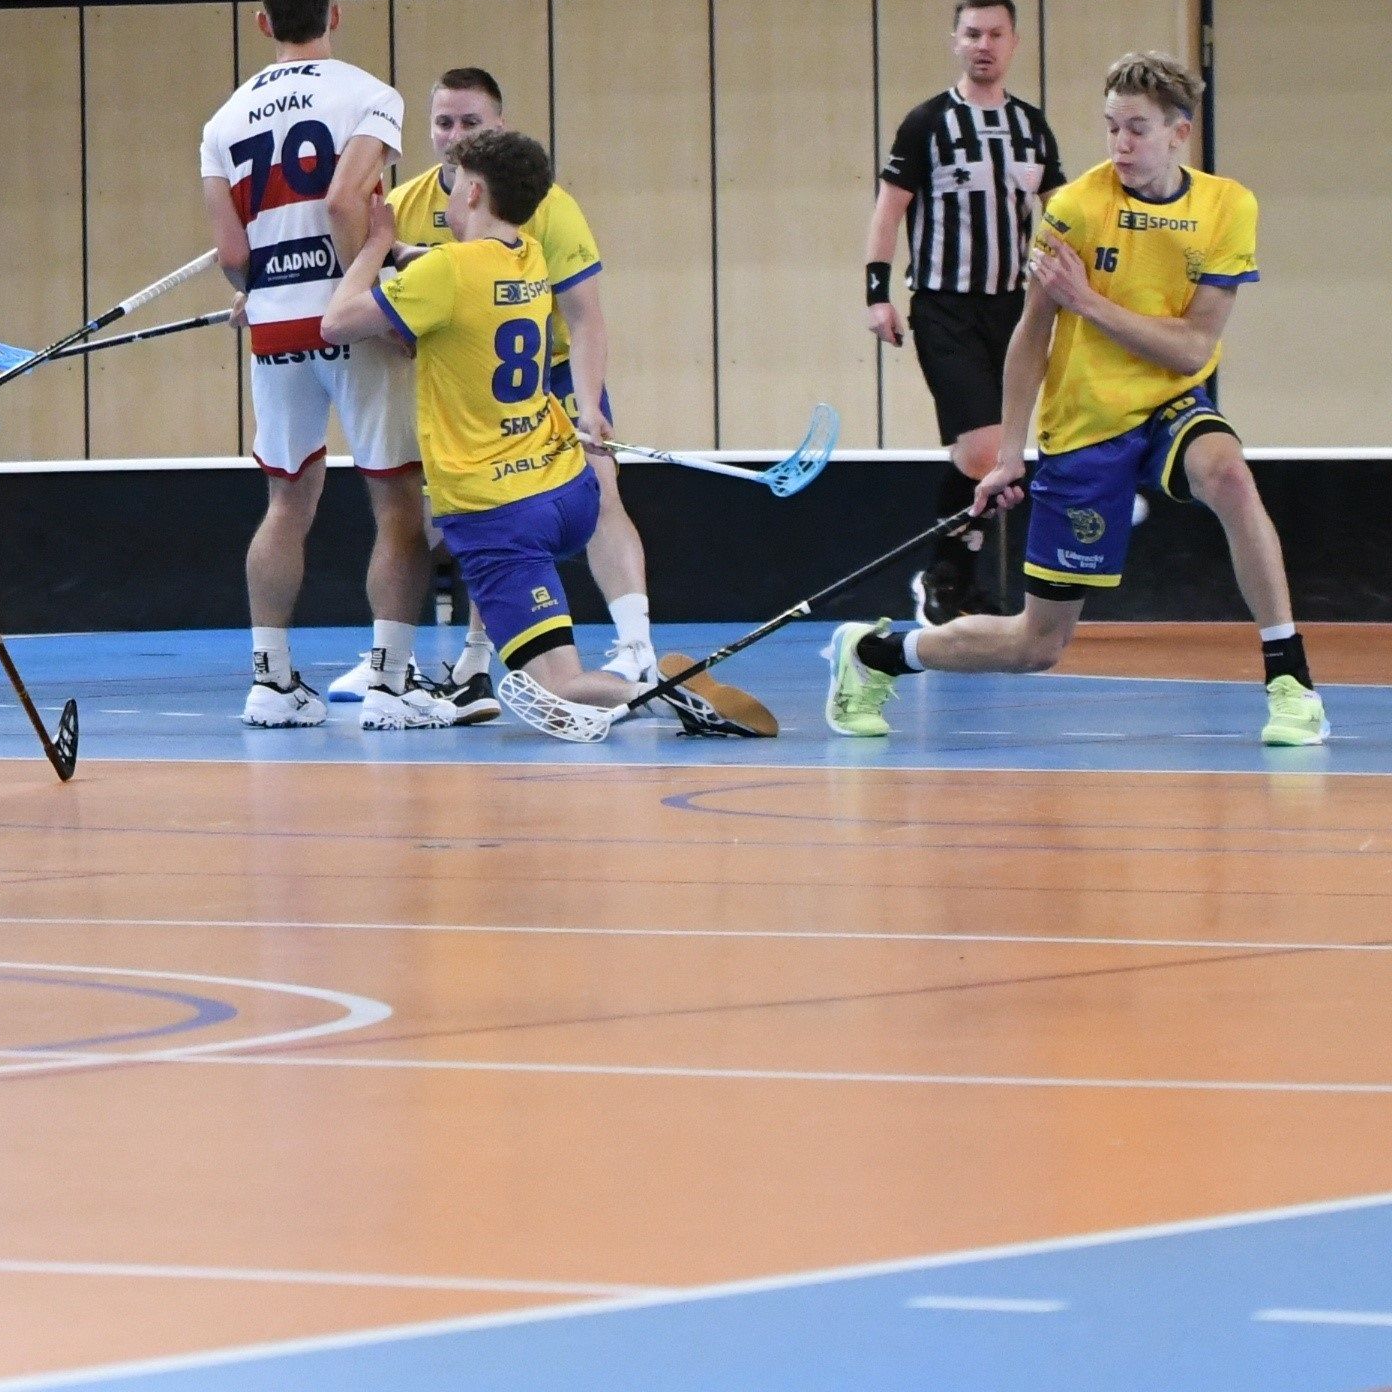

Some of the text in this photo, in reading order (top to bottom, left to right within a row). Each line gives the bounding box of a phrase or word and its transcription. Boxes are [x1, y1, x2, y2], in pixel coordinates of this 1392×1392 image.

[248, 91, 314, 125] NOVÁK
[228, 119, 336, 216] 70
[265, 248, 328, 275] KLADNO
[1094, 246, 1120, 273] 16
[491, 317, 554, 404] 8
